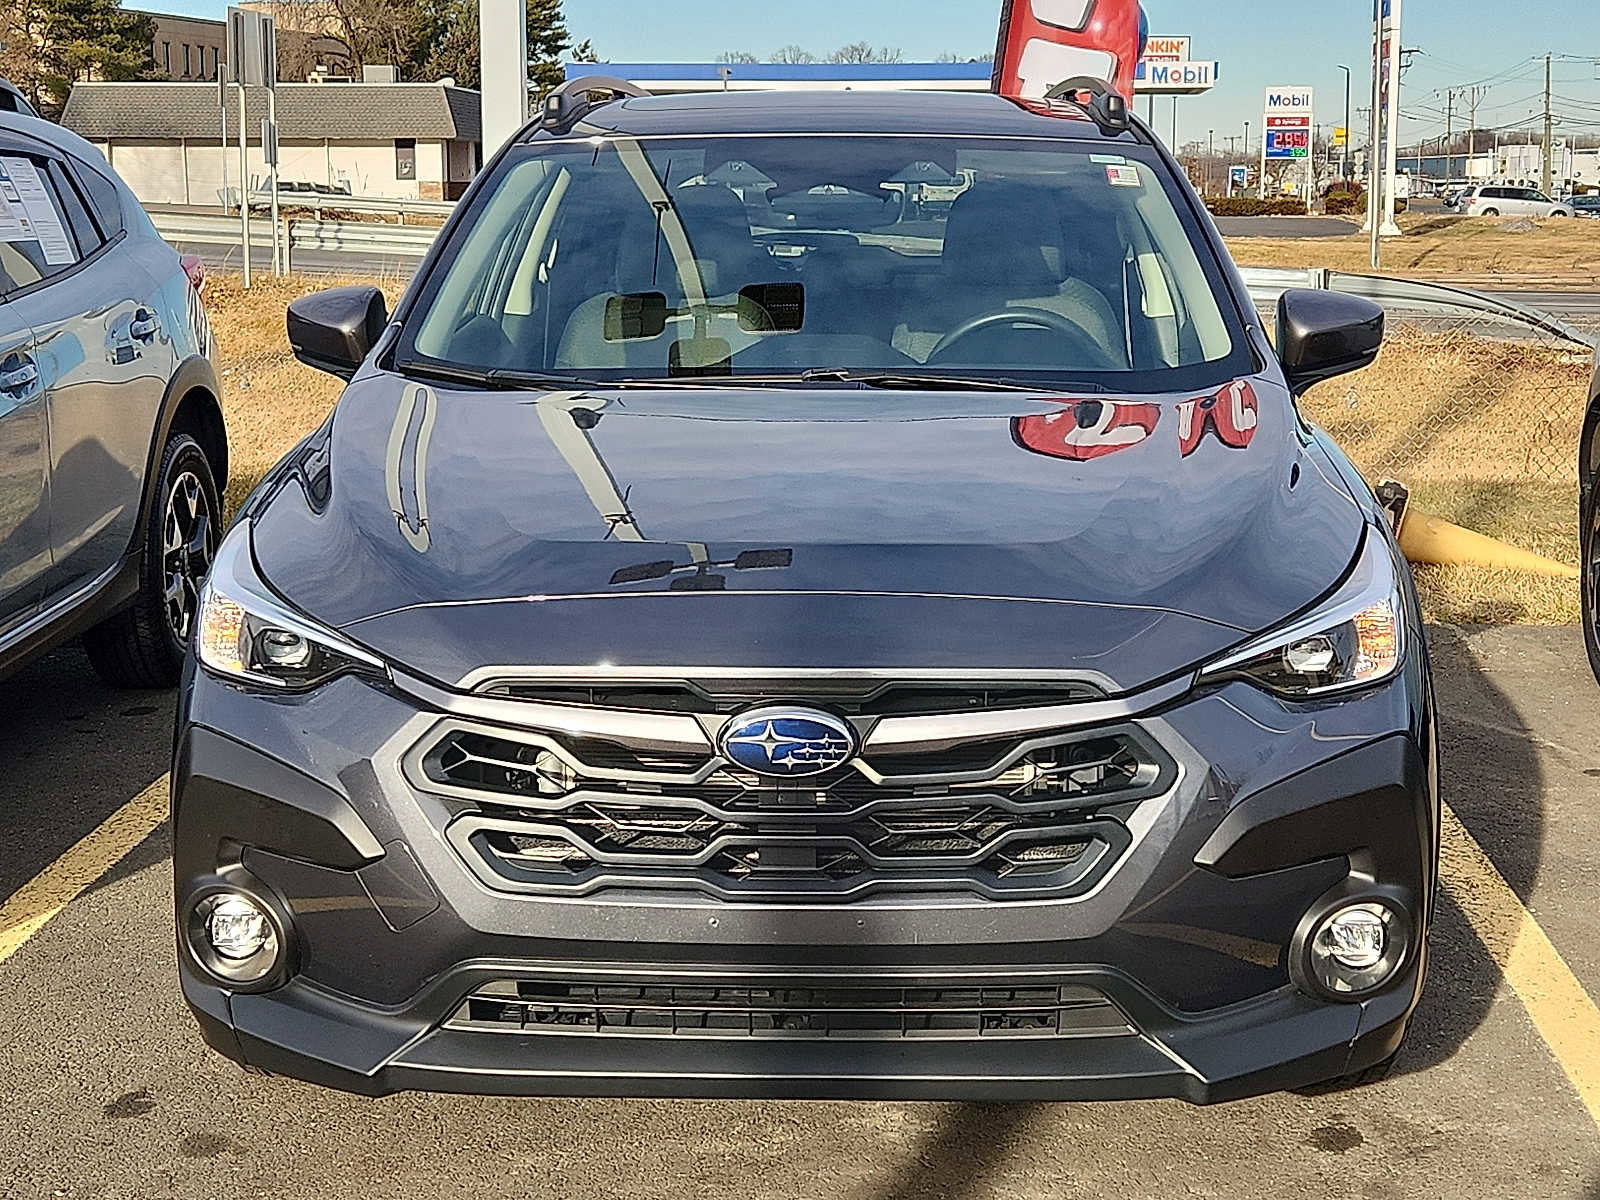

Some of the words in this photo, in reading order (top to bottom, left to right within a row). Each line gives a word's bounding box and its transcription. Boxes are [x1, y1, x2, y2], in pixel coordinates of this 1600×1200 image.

[1147, 41, 1184, 53] NKIN'
[1152, 66, 1208, 84] Mobil
[1269, 94, 1309, 106] Mobil
